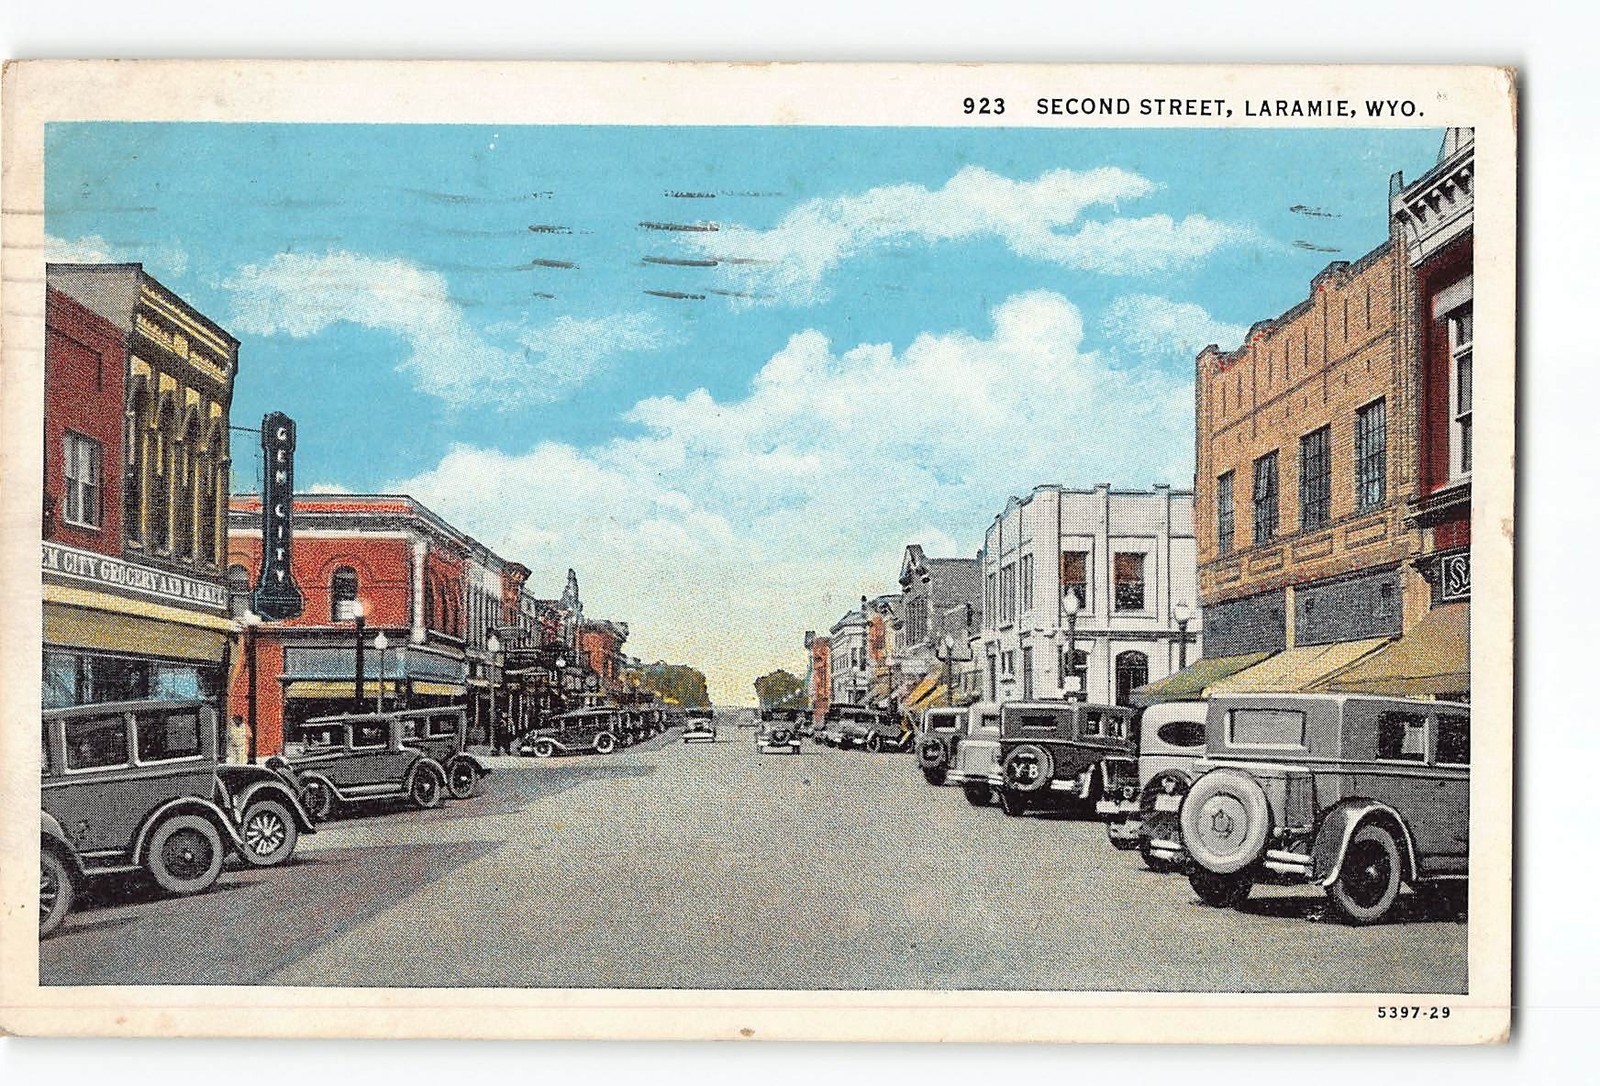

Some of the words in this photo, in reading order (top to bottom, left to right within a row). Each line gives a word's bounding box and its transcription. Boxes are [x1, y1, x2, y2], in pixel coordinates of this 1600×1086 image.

[964, 98, 1004, 114] 923
[1037, 98, 1129, 114] SECOND
[1140, 99, 1232, 117] STREET,
[1246, 100, 1356, 118] LARAMIE,
[1366, 101, 1423, 116] WYO.
[275, 427, 288, 484] GEM
[274, 503, 286, 583] CITY
[63, 552, 98, 577] CITY
[100, 561, 159, 591] GROCERY
[159, 575, 183, 595] AND
[1378, 1007, 1450, 1019] 5397-29
